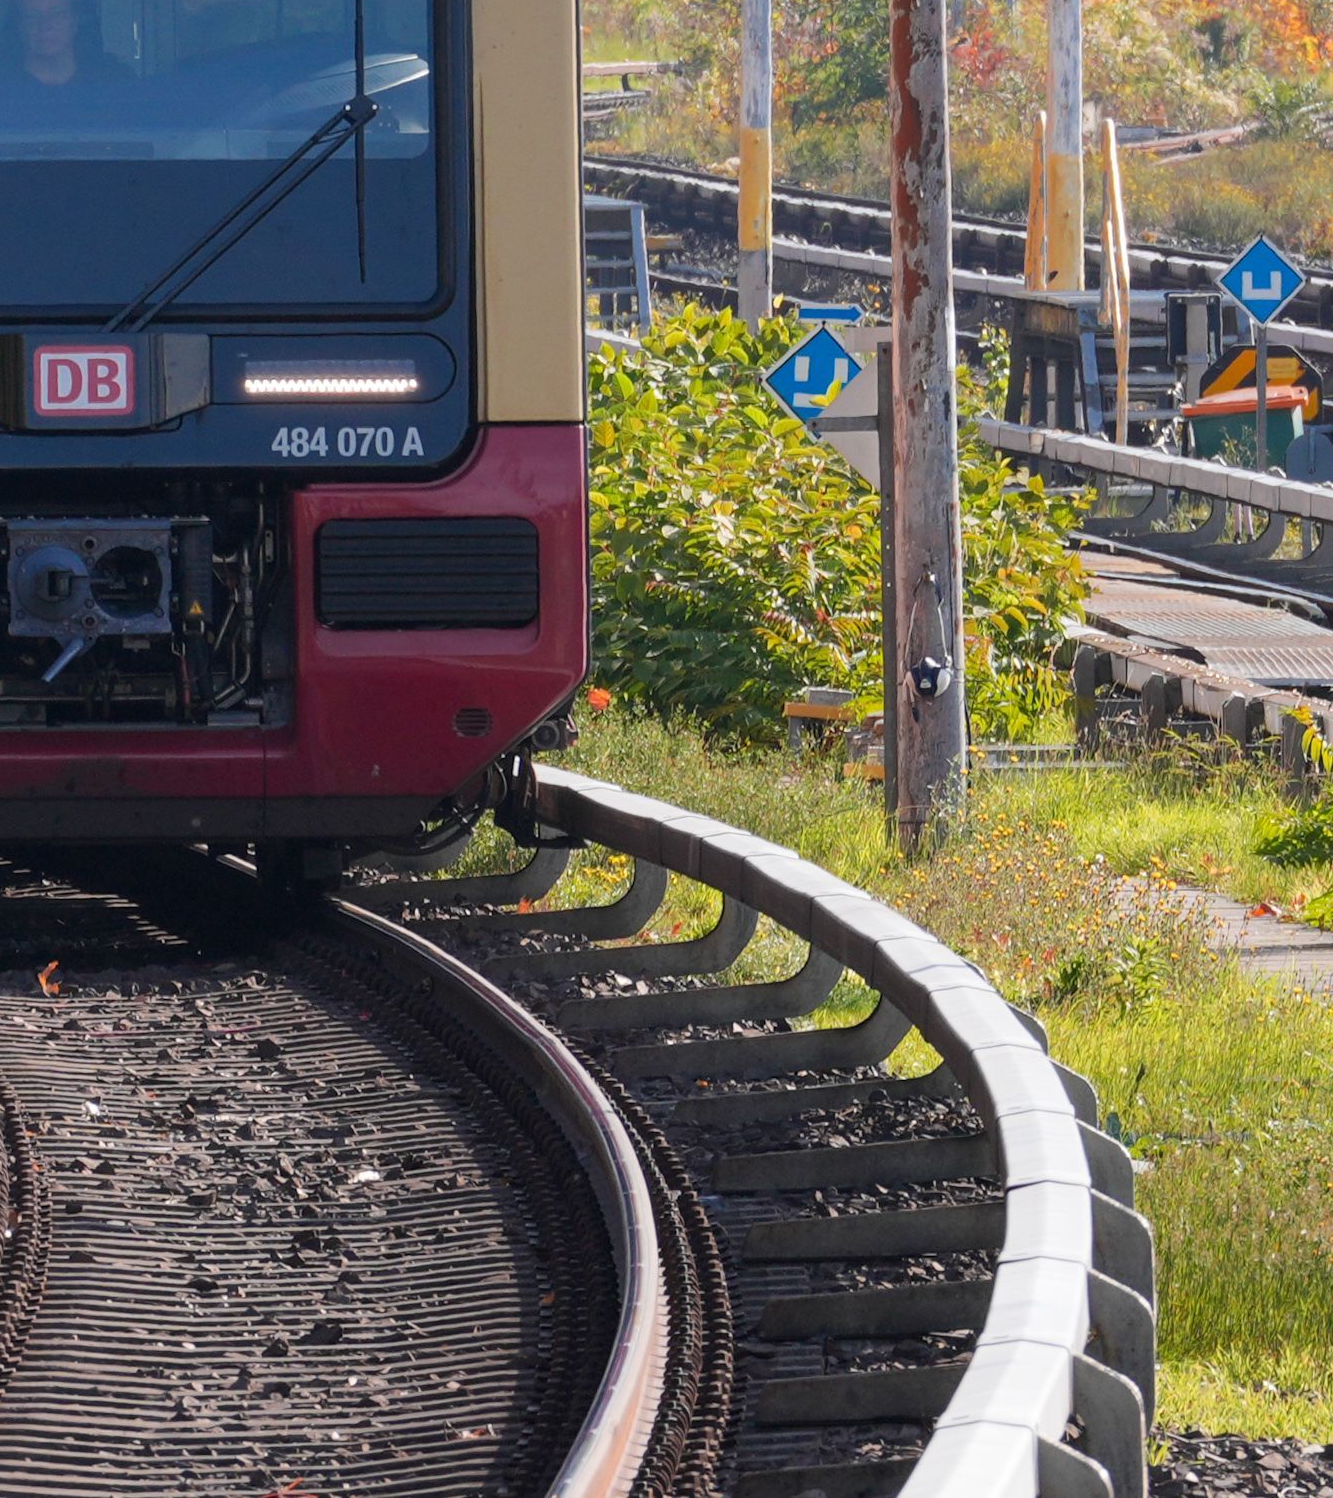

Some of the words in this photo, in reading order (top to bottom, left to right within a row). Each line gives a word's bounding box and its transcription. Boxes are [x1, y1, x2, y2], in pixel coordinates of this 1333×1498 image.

[45, 356, 123, 406] DB
[270, 426, 329, 458] 484
[336, 426, 395, 458] 070
[400, 426, 426, 458] A
